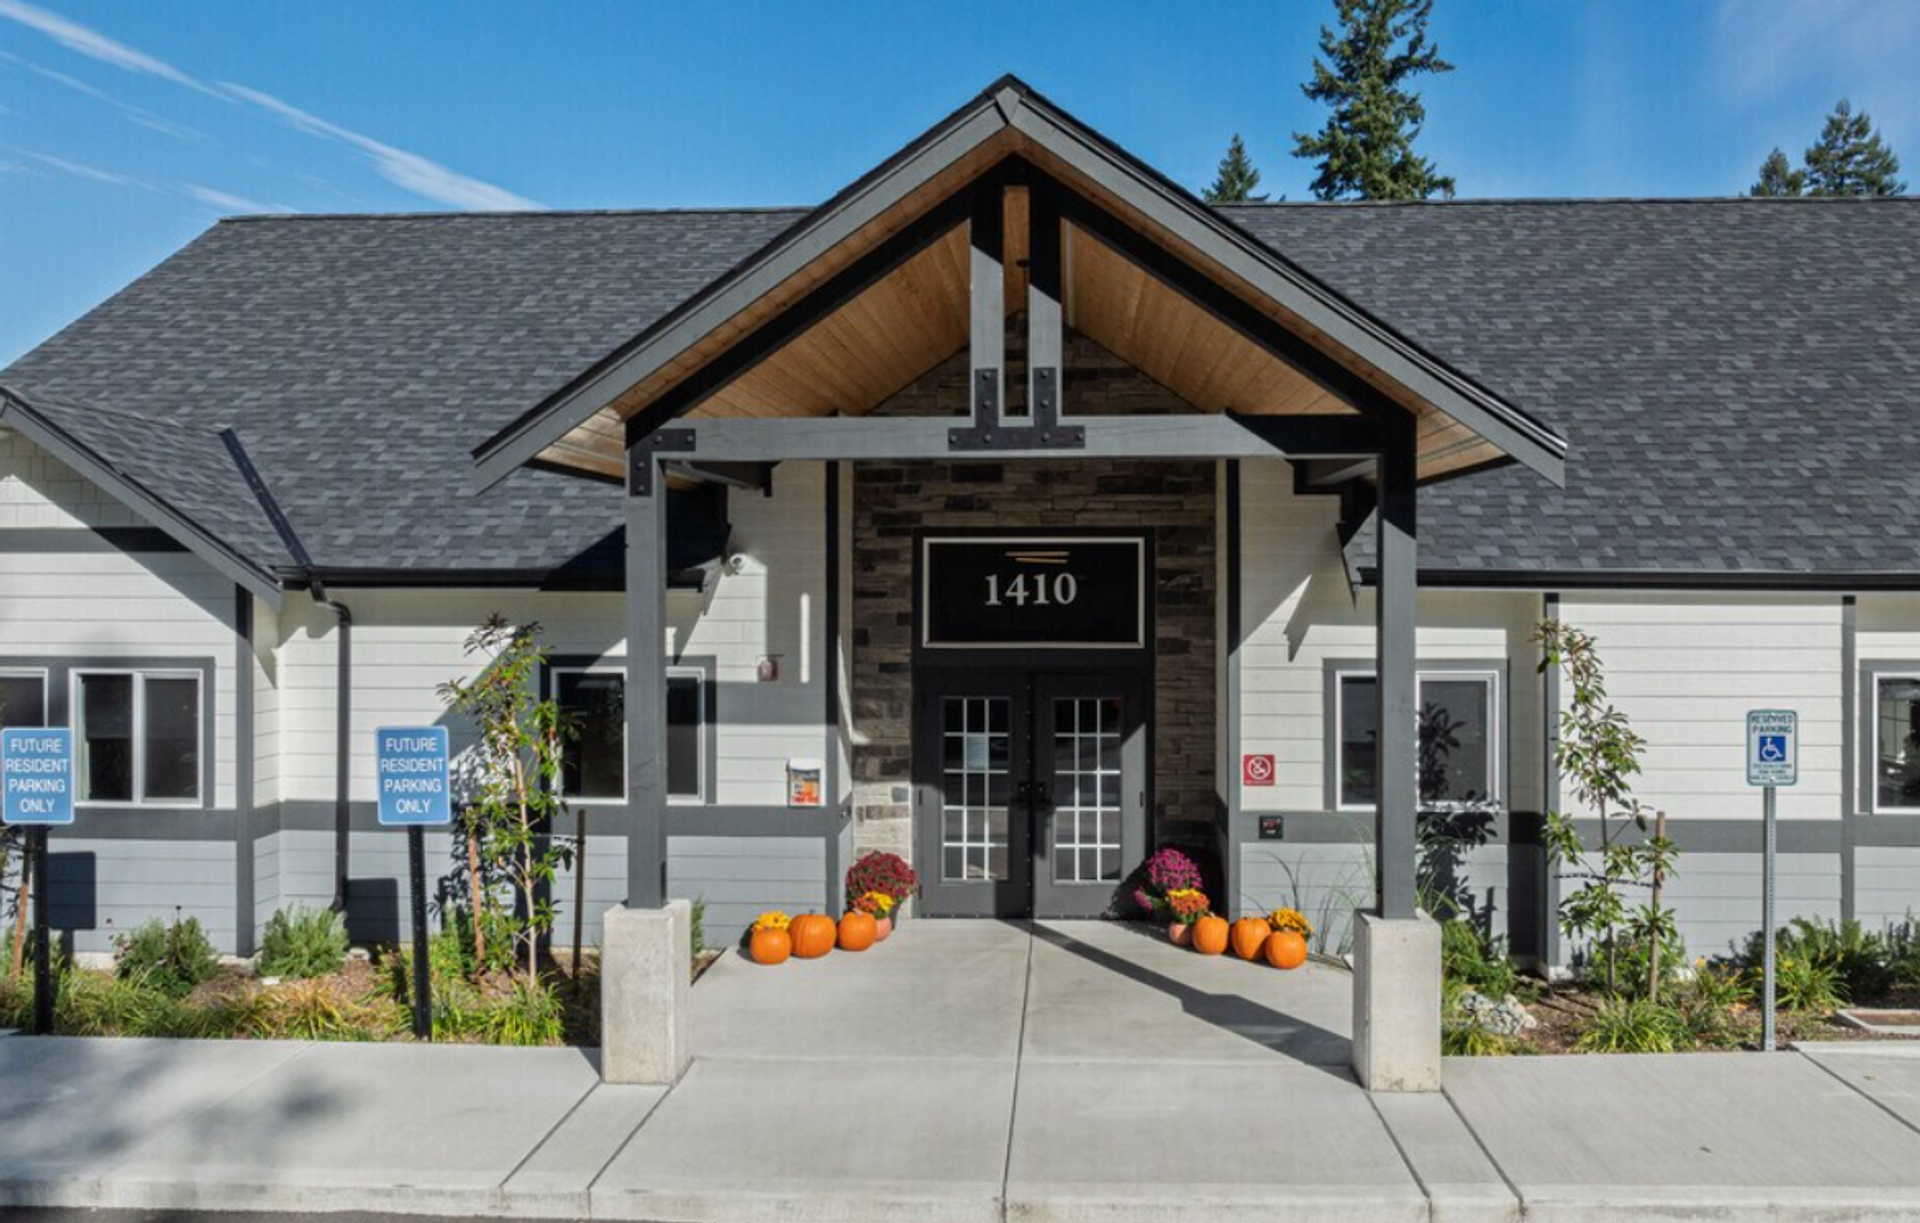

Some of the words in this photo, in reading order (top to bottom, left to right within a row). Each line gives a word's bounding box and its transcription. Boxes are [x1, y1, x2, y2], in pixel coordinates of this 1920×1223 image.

[984, 572, 1077, 606] 1410
[1752, 725, 1793, 734] PARKING
[10, 737, 63, 753] FUTURE
[385, 737, 438, 753] FUTURE
[5, 758, 69, 773] RESIDENT
[381, 757, 444, 773] RESIDENT
[8, 778, 66, 793] PARKING
[384, 778, 442, 793] PARKING
[20, 797, 56, 813] ONLY
[395, 797, 432, 813] ONLY
